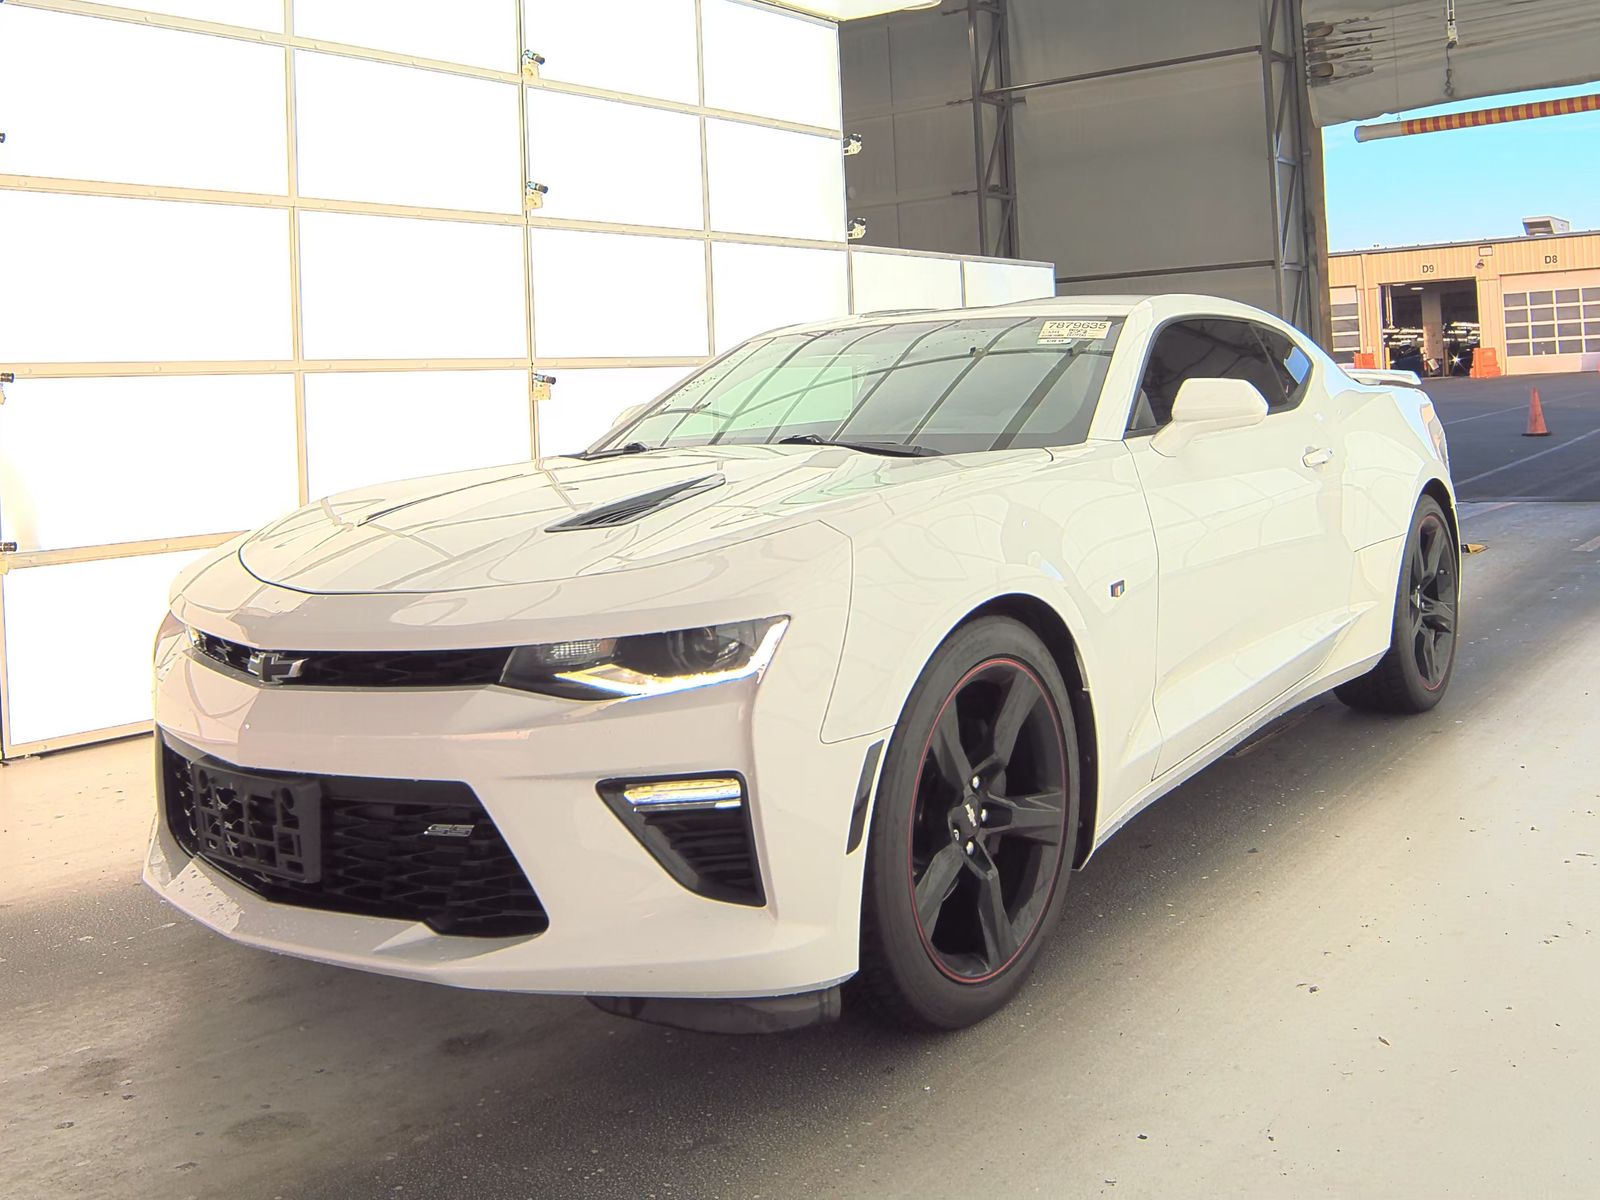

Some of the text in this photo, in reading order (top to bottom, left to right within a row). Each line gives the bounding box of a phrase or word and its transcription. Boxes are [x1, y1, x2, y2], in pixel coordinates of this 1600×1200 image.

[1544, 255, 1558, 264] D8
[1422, 265, 1434, 273] D9
[1048, 321, 1107, 329] 7879635
